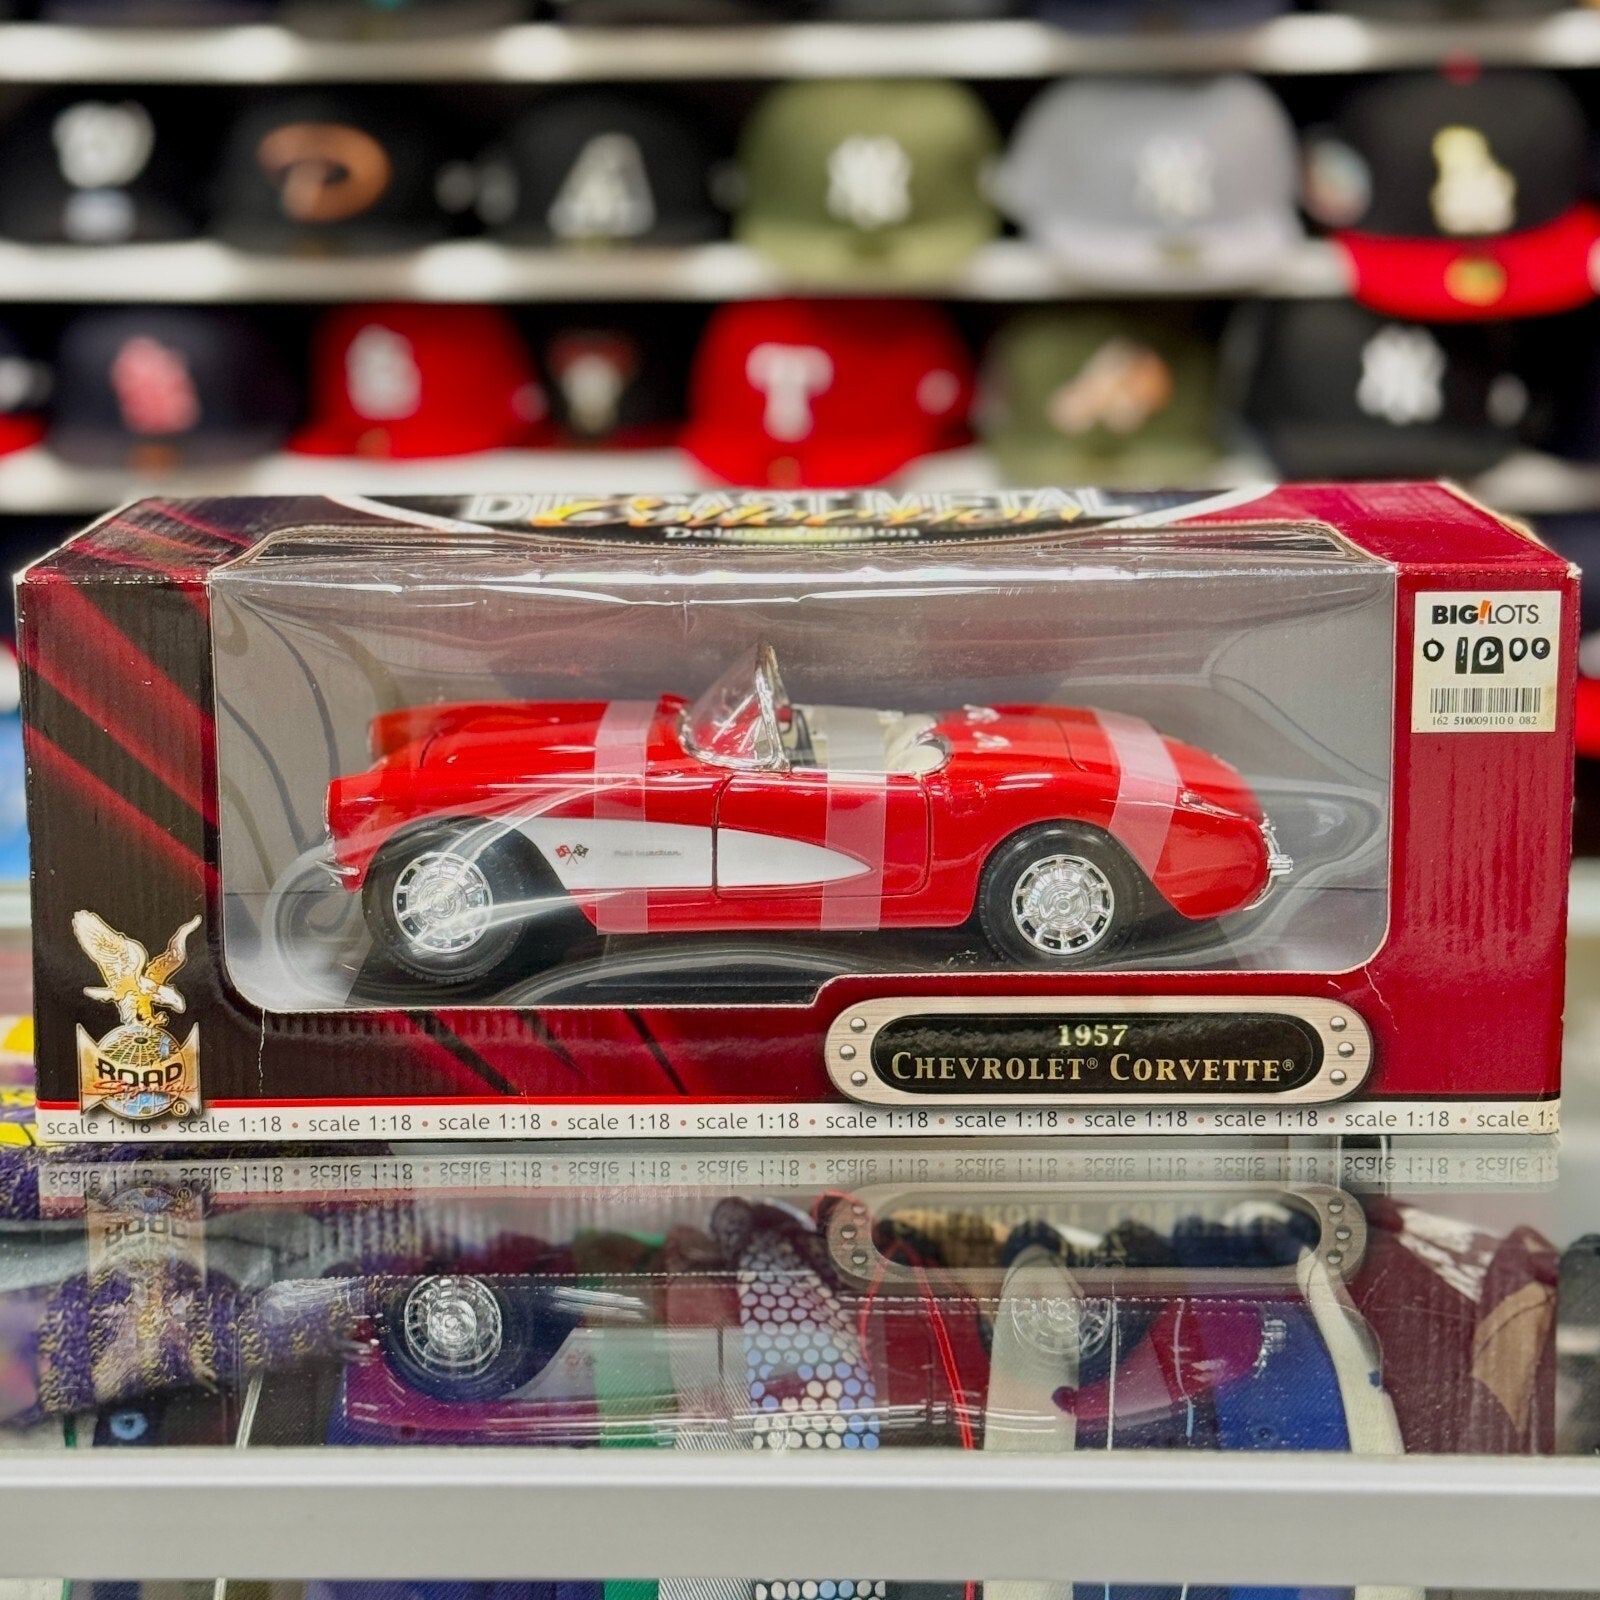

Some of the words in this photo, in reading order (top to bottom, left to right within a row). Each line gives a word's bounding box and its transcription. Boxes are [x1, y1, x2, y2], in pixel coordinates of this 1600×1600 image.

[1432, 715, 1449, 726] 162
[1518, 715, 1538, 726] 082
[1057, 1024, 1129, 1046] 1957
[95, 1056, 184, 1088] ROAD
[47, 1118, 99, 1135] scale
[177, 1116, 229, 1133] scale
[238, 1116, 282, 1132] 1:18
[309, 1115, 360, 1132] scale
[369, 1114, 411, 1131] 1:18
[439, 1113, 490, 1130] scale
[499, 1113, 540, 1130] 1:18
[568, 1113, 618, 1130] scale
[627, 1113, 670, 1129] 1:18
[697, 1112, 747, 1129] scale
[756, 1112, 799, 1129] 1:18
[825, 1112, 877, 1129] scale
[886, 1111, 929, 1128] 1:18
[955, 1111, 1007, 1128] scale
[1015, 1111, 1058, 1127] 1:18
[1084, 1110, 1136, 1128] scale
[1144, 1110, 1188, 1127] 1:18
[1214, 1110, 1266, 1128] scale
[1275, 1110, 1318, 1127] 1:18
[1344, 1110, 1397, 1128] scale
[1406, 1110, 1450, 1127] 1:18
[1476, 1110, 1530, 1127] scale
